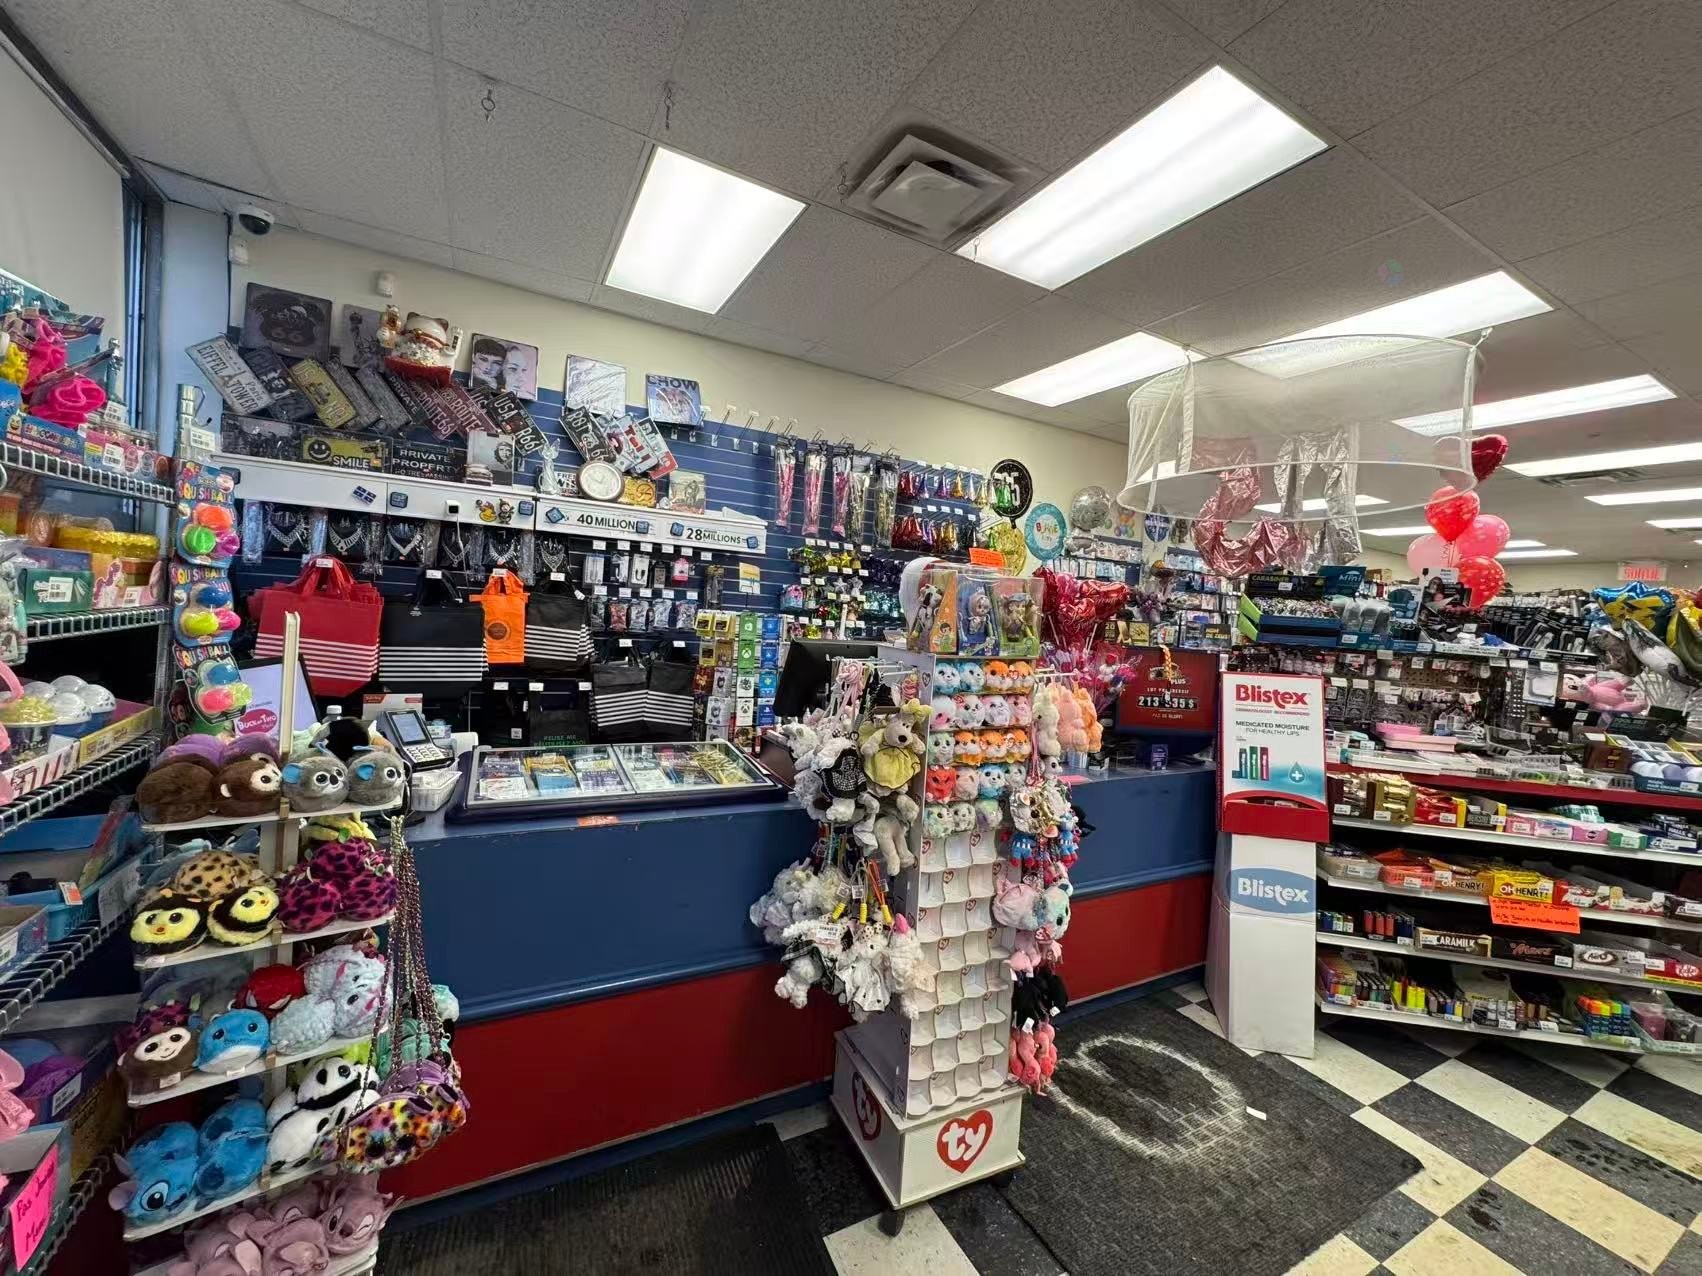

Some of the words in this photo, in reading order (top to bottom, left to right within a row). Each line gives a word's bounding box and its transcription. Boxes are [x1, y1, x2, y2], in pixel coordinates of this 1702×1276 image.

[227, 379, 259, 414] TOWER
[494, 395, 518, 420] USA
[333, 456, 371, 469] SMILE
[577, 513, 593, 525] 40
[594, 516, 636, 531] MILLION
[686, 527, 703, 541] 28
[703, 532, 742, 544] MILLIONS
[1138, 696, 1160, 707] 213
[1235, 683, 1309, 709] Blistex
[1235, 720, 1274, 729] MEDICATED
[1274, 723, 1311, 731] MOISTURE
[1237, 876, 1310, 906] Blistex
[1435, 934, 1476, 948] CARAMILK
[942, 1122, 987, 1161] ty
